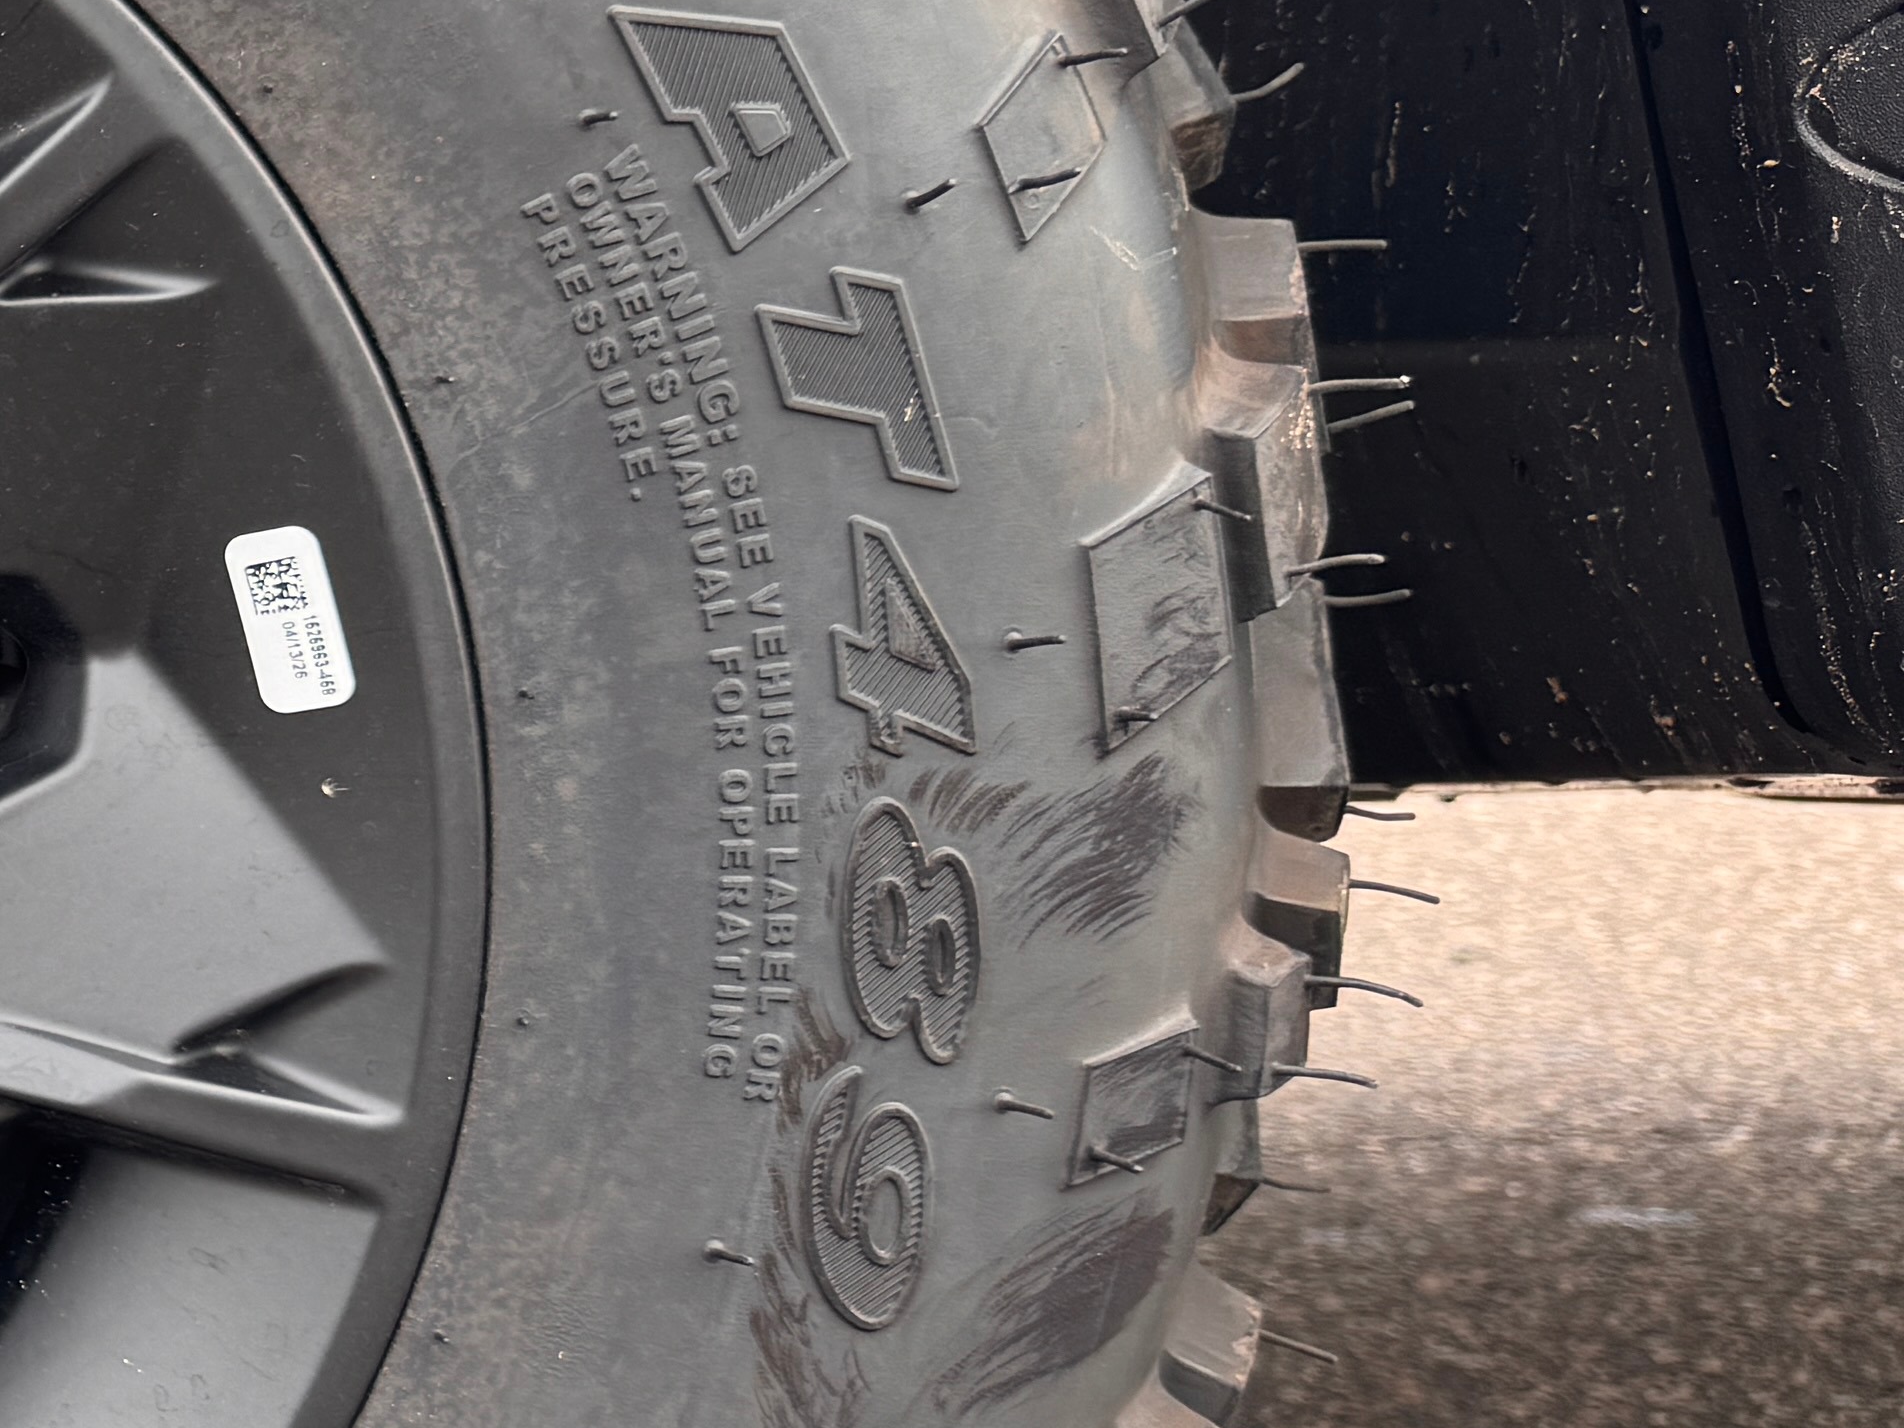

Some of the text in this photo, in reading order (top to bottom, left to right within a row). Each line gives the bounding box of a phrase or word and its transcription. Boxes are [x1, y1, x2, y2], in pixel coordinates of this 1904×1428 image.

[282, 621, 308, 679] 04/13/26
[521, 192, 661, 503] PRESSURE.
[565, 171, 754, 1079] OWNER'S MANUAL FOR OPERATING
[606, 143, 802, 1104] WARNING: SEE VEHICLE LABEL OR
[607, 4, 982, 1332] AT489
